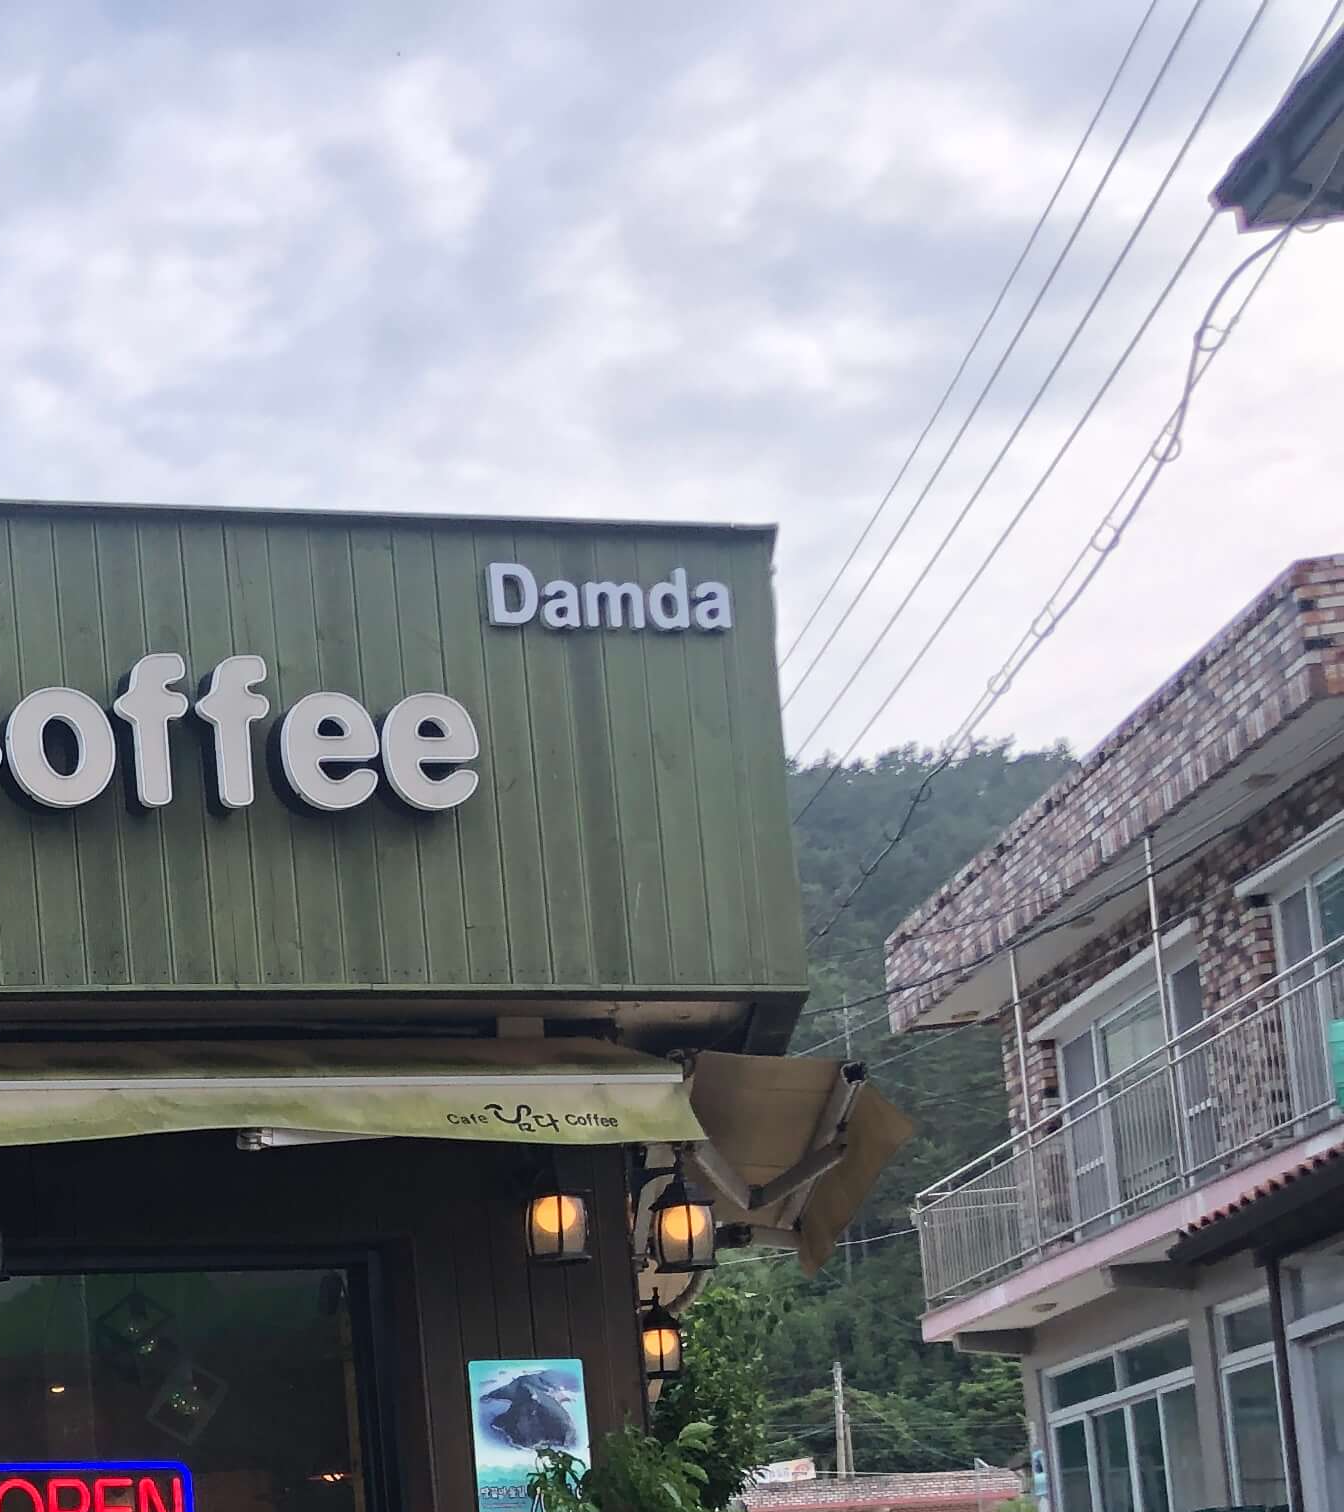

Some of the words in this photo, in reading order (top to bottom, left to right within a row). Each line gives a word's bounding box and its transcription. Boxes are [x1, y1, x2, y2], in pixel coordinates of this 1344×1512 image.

[485, 563, 733, 630] Damda
[484, 1103, 560, 1133] 담다
[565, 1113, 620, 1128] Coffee
